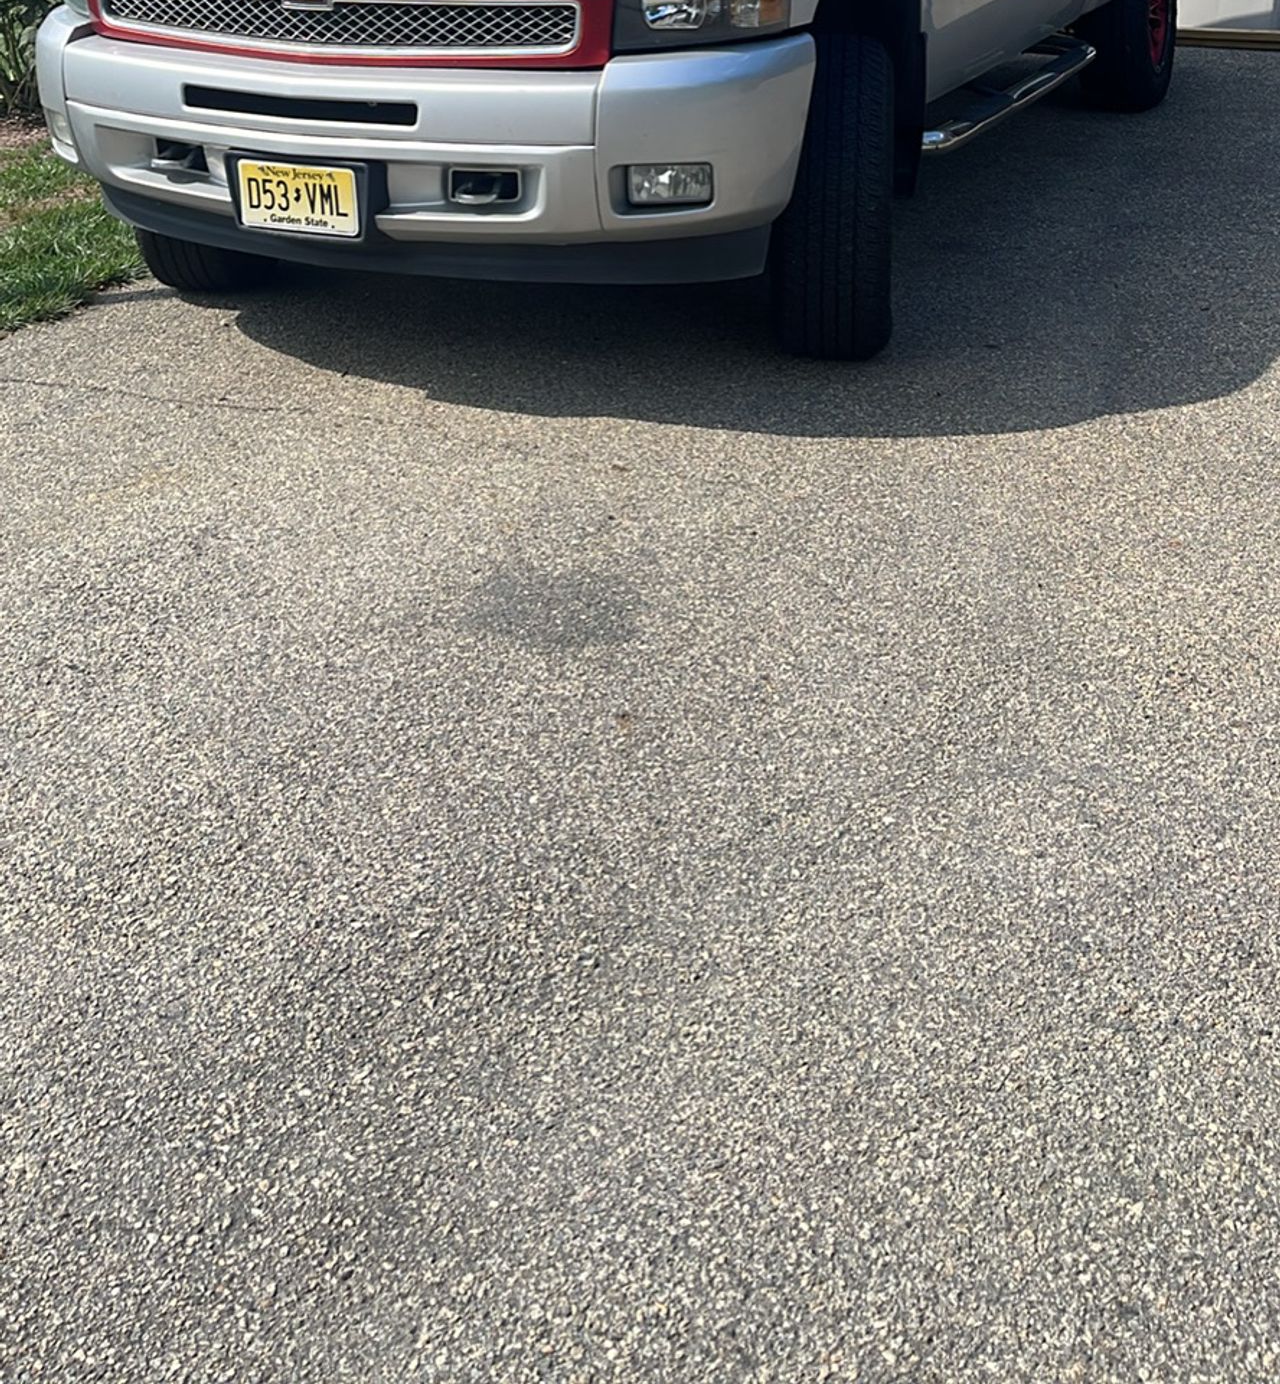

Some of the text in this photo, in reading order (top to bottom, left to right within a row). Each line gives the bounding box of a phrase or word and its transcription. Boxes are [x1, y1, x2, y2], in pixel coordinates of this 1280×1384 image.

[266, 166, 324, 181] New Jersey
[247, 177, 349, 218] D53 VML
[270, 213, 329, 228] Garden State
